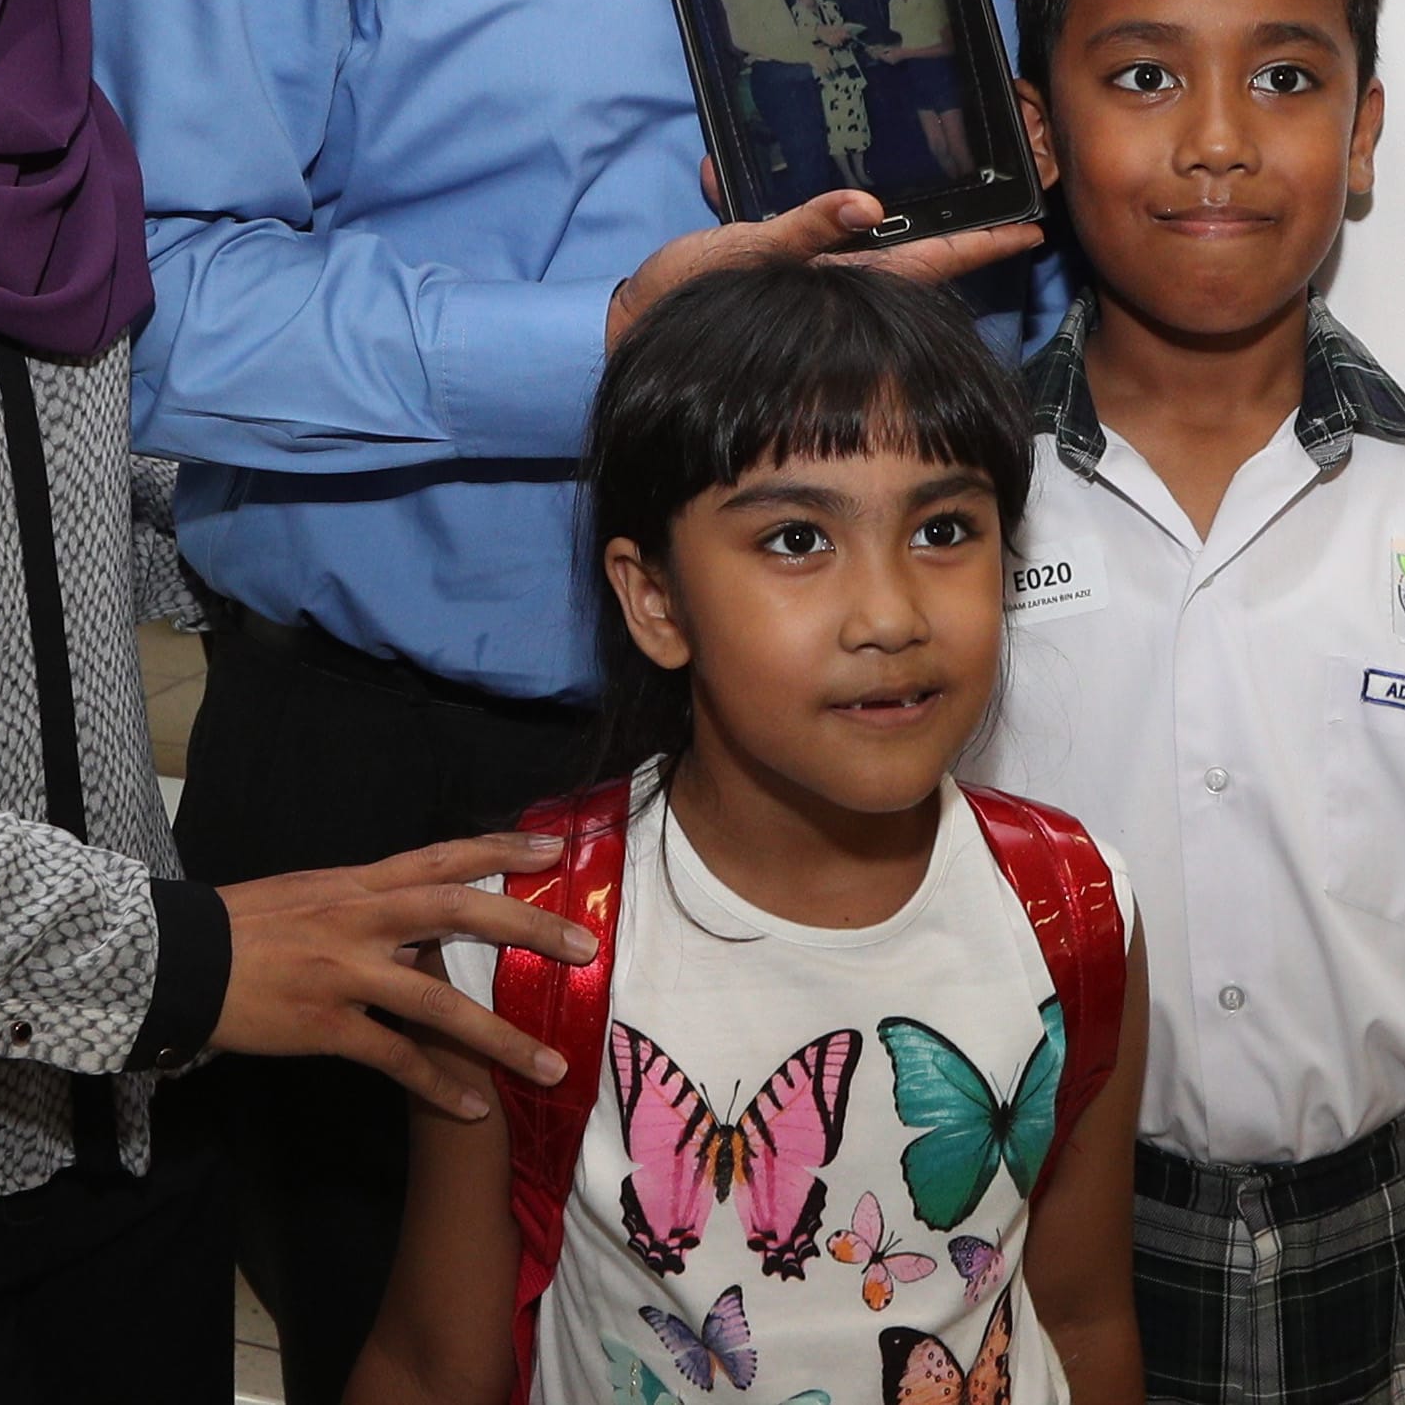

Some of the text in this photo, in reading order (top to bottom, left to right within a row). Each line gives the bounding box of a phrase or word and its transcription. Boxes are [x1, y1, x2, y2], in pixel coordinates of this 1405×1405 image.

[1013, 562, 1073, 593] E020
[1027, 596, 1058, 609] ZAFRAN
[1060, 592, 1073, 603] BIN
[1075, 588, 1092, 600] AZIZ
